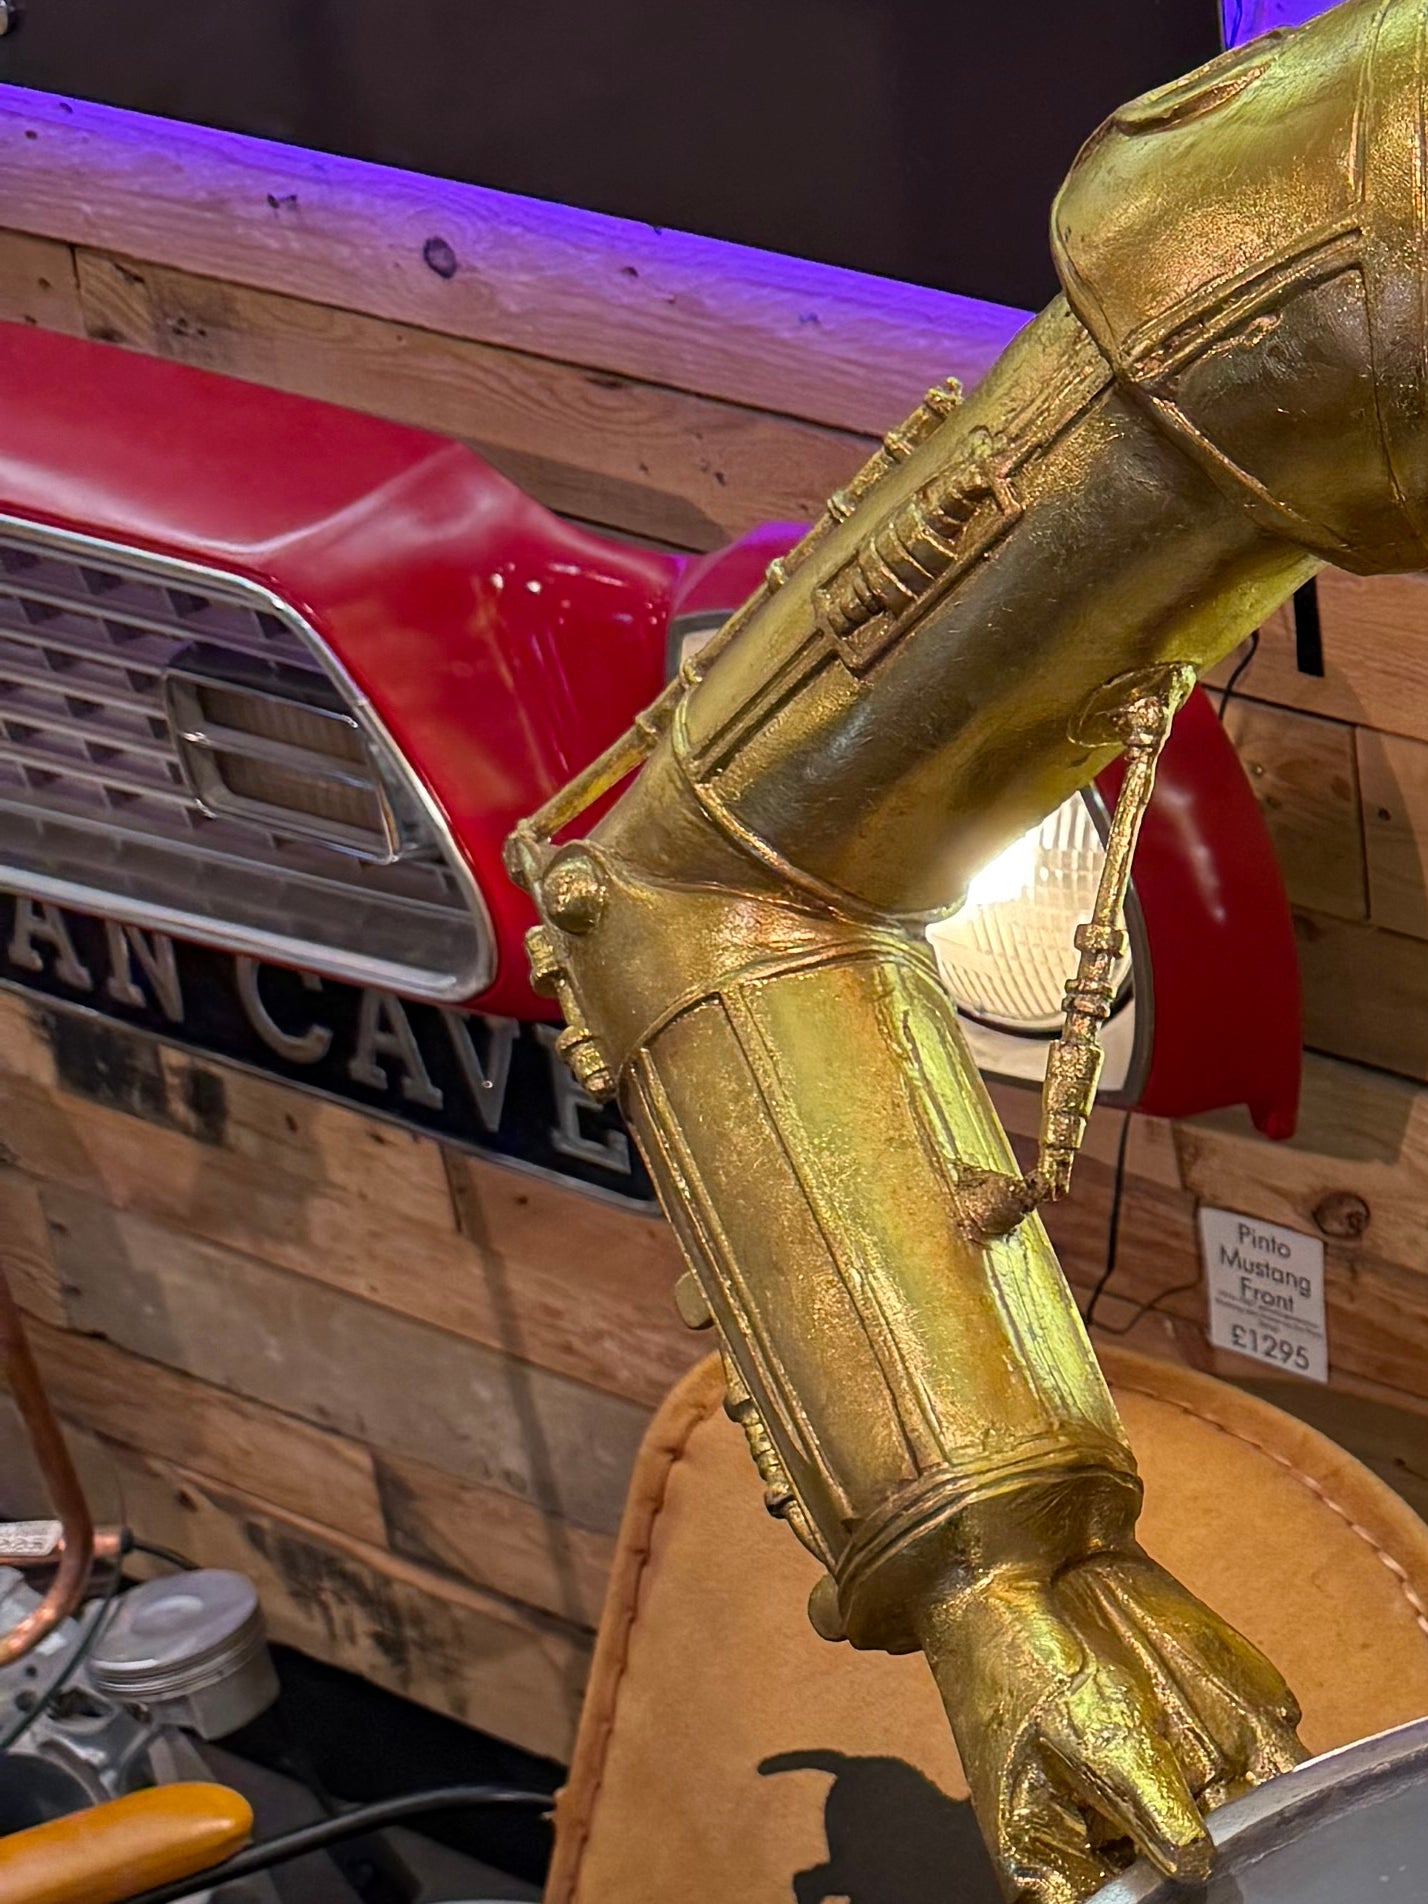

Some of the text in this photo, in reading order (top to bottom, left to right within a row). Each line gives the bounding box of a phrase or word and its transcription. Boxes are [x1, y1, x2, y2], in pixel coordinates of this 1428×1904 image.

[233, 955, 632, 1176] CAVE
[1237, 1221, 1292, 1260] Pinto
[1218, 1244, 1312, 1299] Mustang
[1240, 1276, 1294, 1313] Front
[1230, 1323, 1310, 1371] £1295
